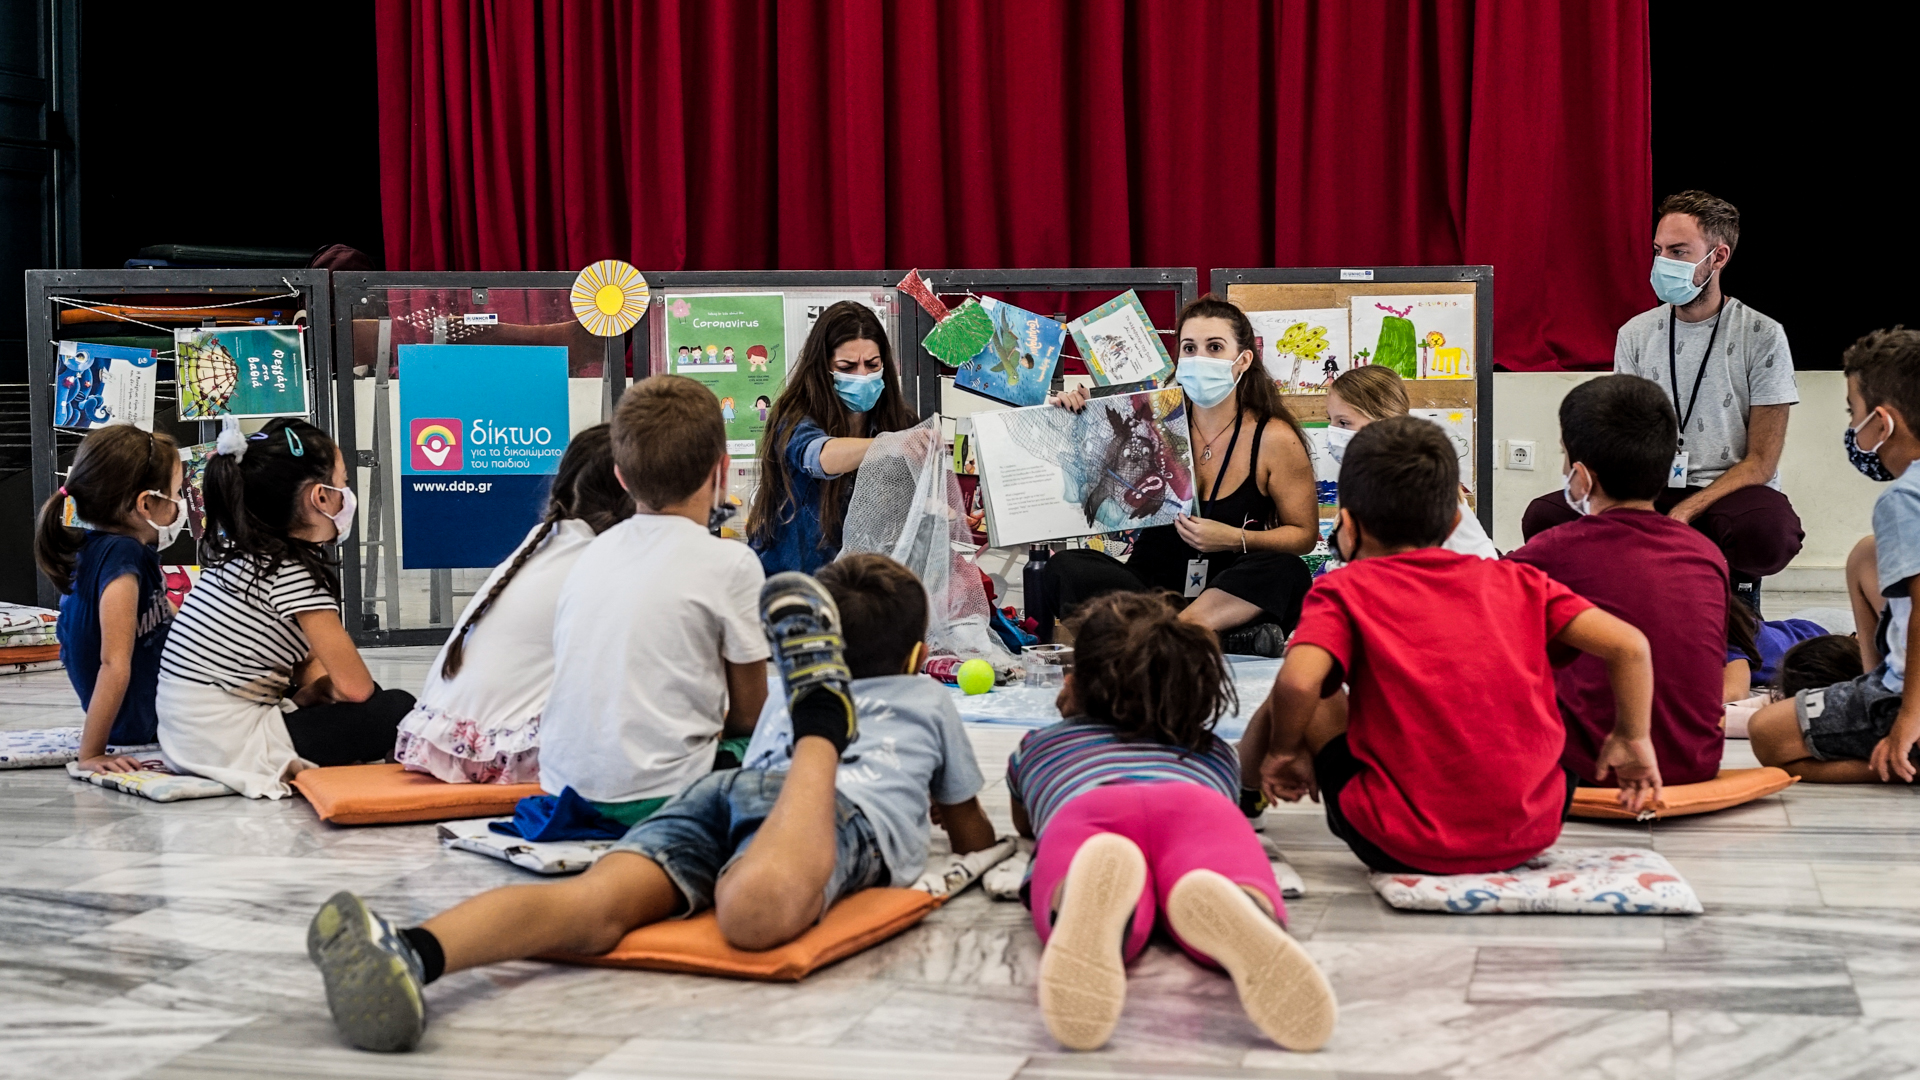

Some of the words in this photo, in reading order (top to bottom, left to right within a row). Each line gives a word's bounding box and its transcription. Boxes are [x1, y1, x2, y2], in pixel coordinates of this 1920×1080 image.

[693, 318, 759, 328] Coronavirus
[247, 357, 262, 388] βαθιά
[262, 364, 270, 381] στα
[270, 349, 288, 392] Φεγγάρι
[470, 419, 551, 445] δίκτυο
[471, 449, 486, 459] για
[504, 446, 562, 458] δικαιώματα
[492, 458, 530, 468] παιδιού
[413, 480, 492, 493] www.ddp.gr
